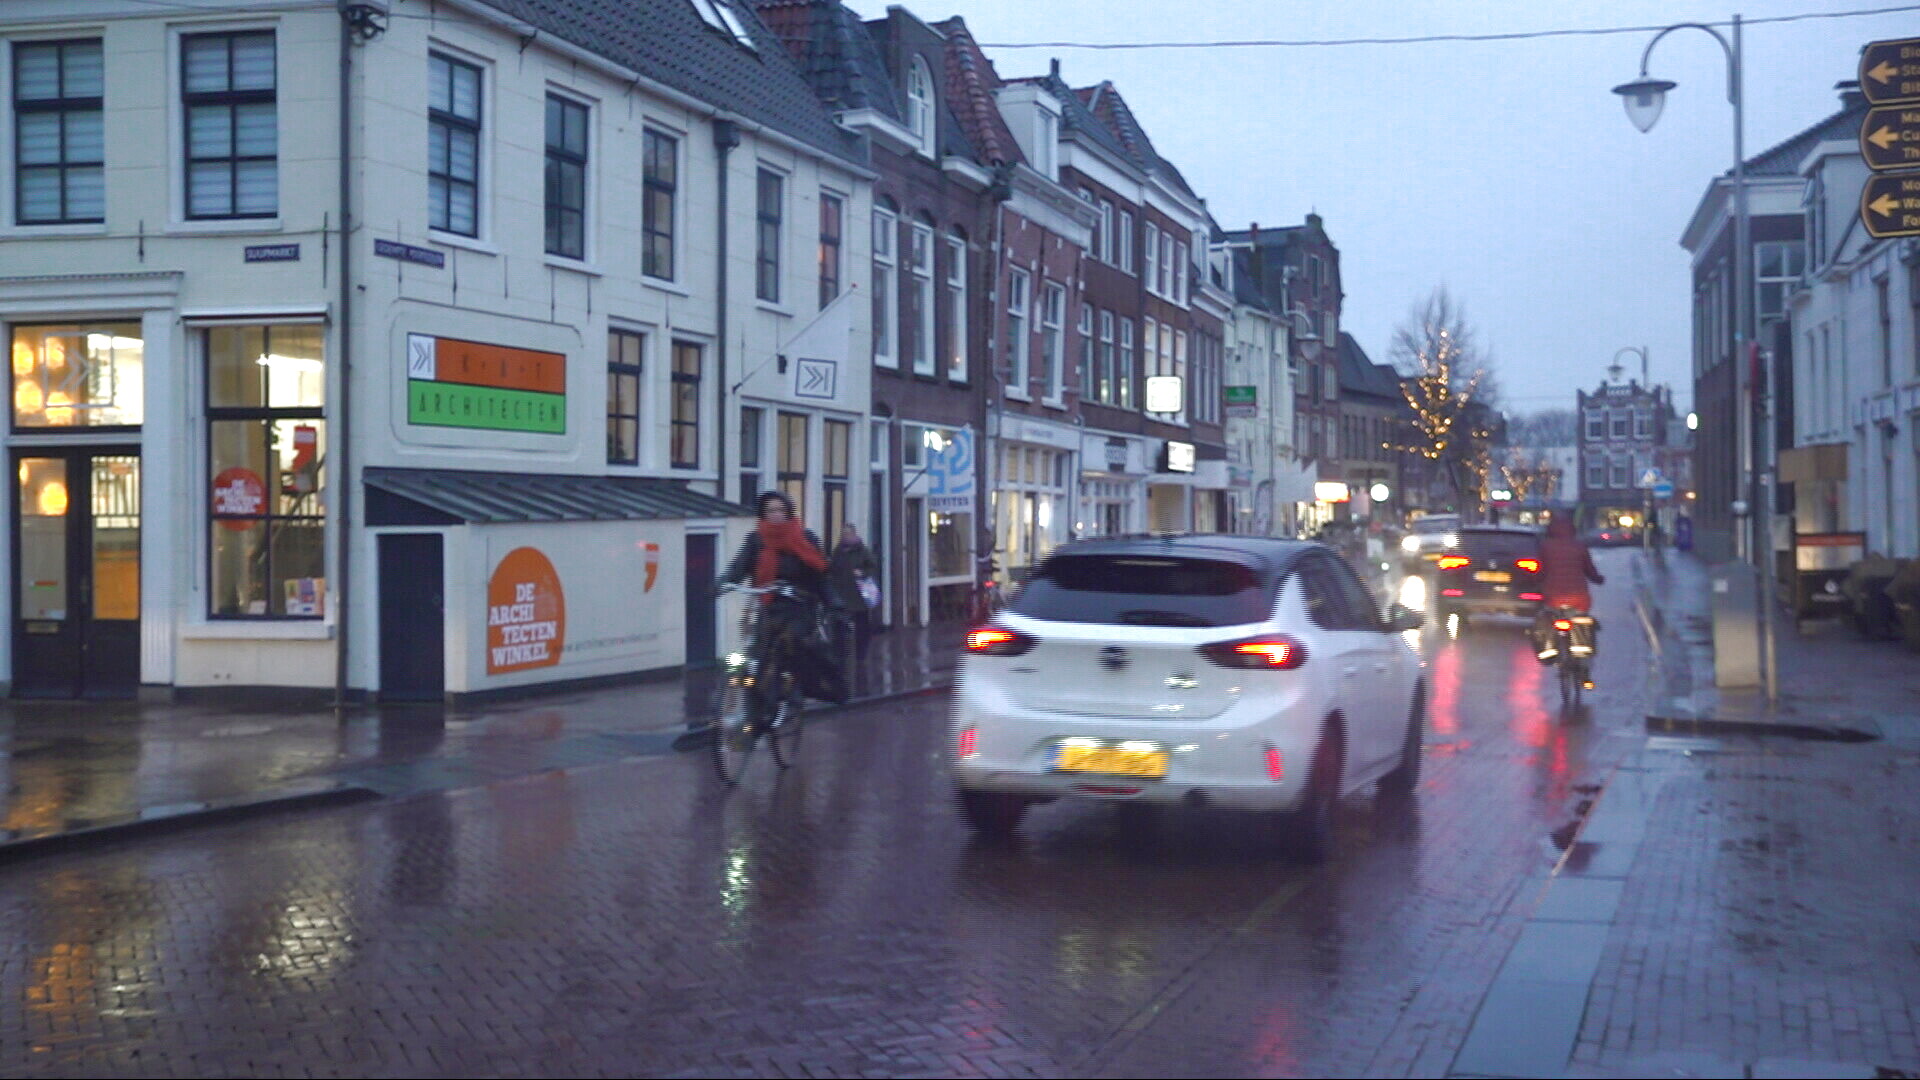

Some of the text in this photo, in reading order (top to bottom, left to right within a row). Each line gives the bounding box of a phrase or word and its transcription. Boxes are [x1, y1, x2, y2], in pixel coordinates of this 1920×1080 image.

[419, 392, 558, 423] ARCHITECTEN
[515, 583, 535, 602] DE
[490, 603, 534, 625] ARCHI
[502, 621, 556, 644] TECTEN
[492, 644, 549, 666] WINKEL
